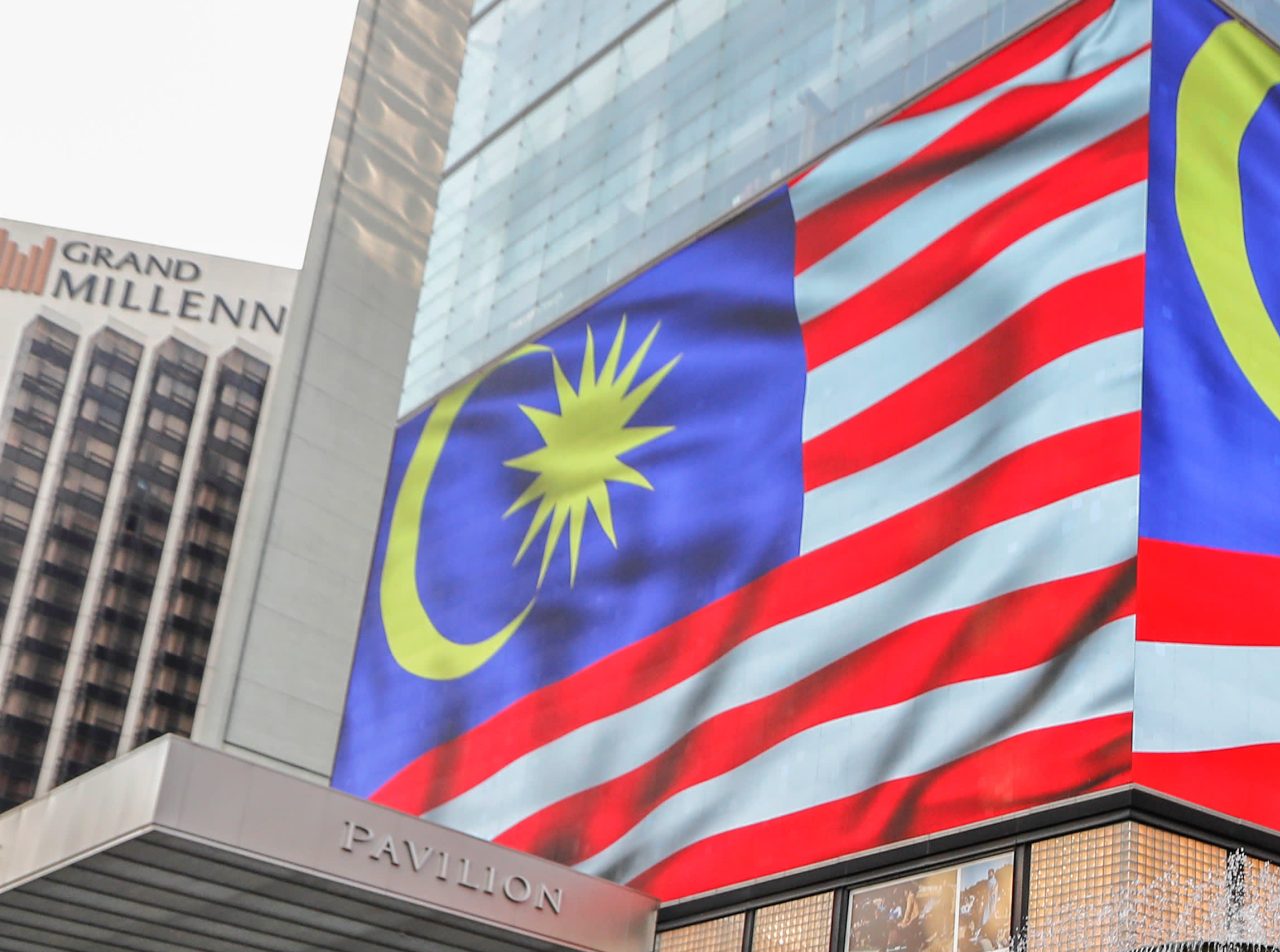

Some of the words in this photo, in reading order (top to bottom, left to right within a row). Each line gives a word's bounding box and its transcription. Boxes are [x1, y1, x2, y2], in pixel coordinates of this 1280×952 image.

[61, 240, 203, 283] GRAND
[51, 268, 288, 335] MILLENN
[340, 820, 563, 915] PAVILION
